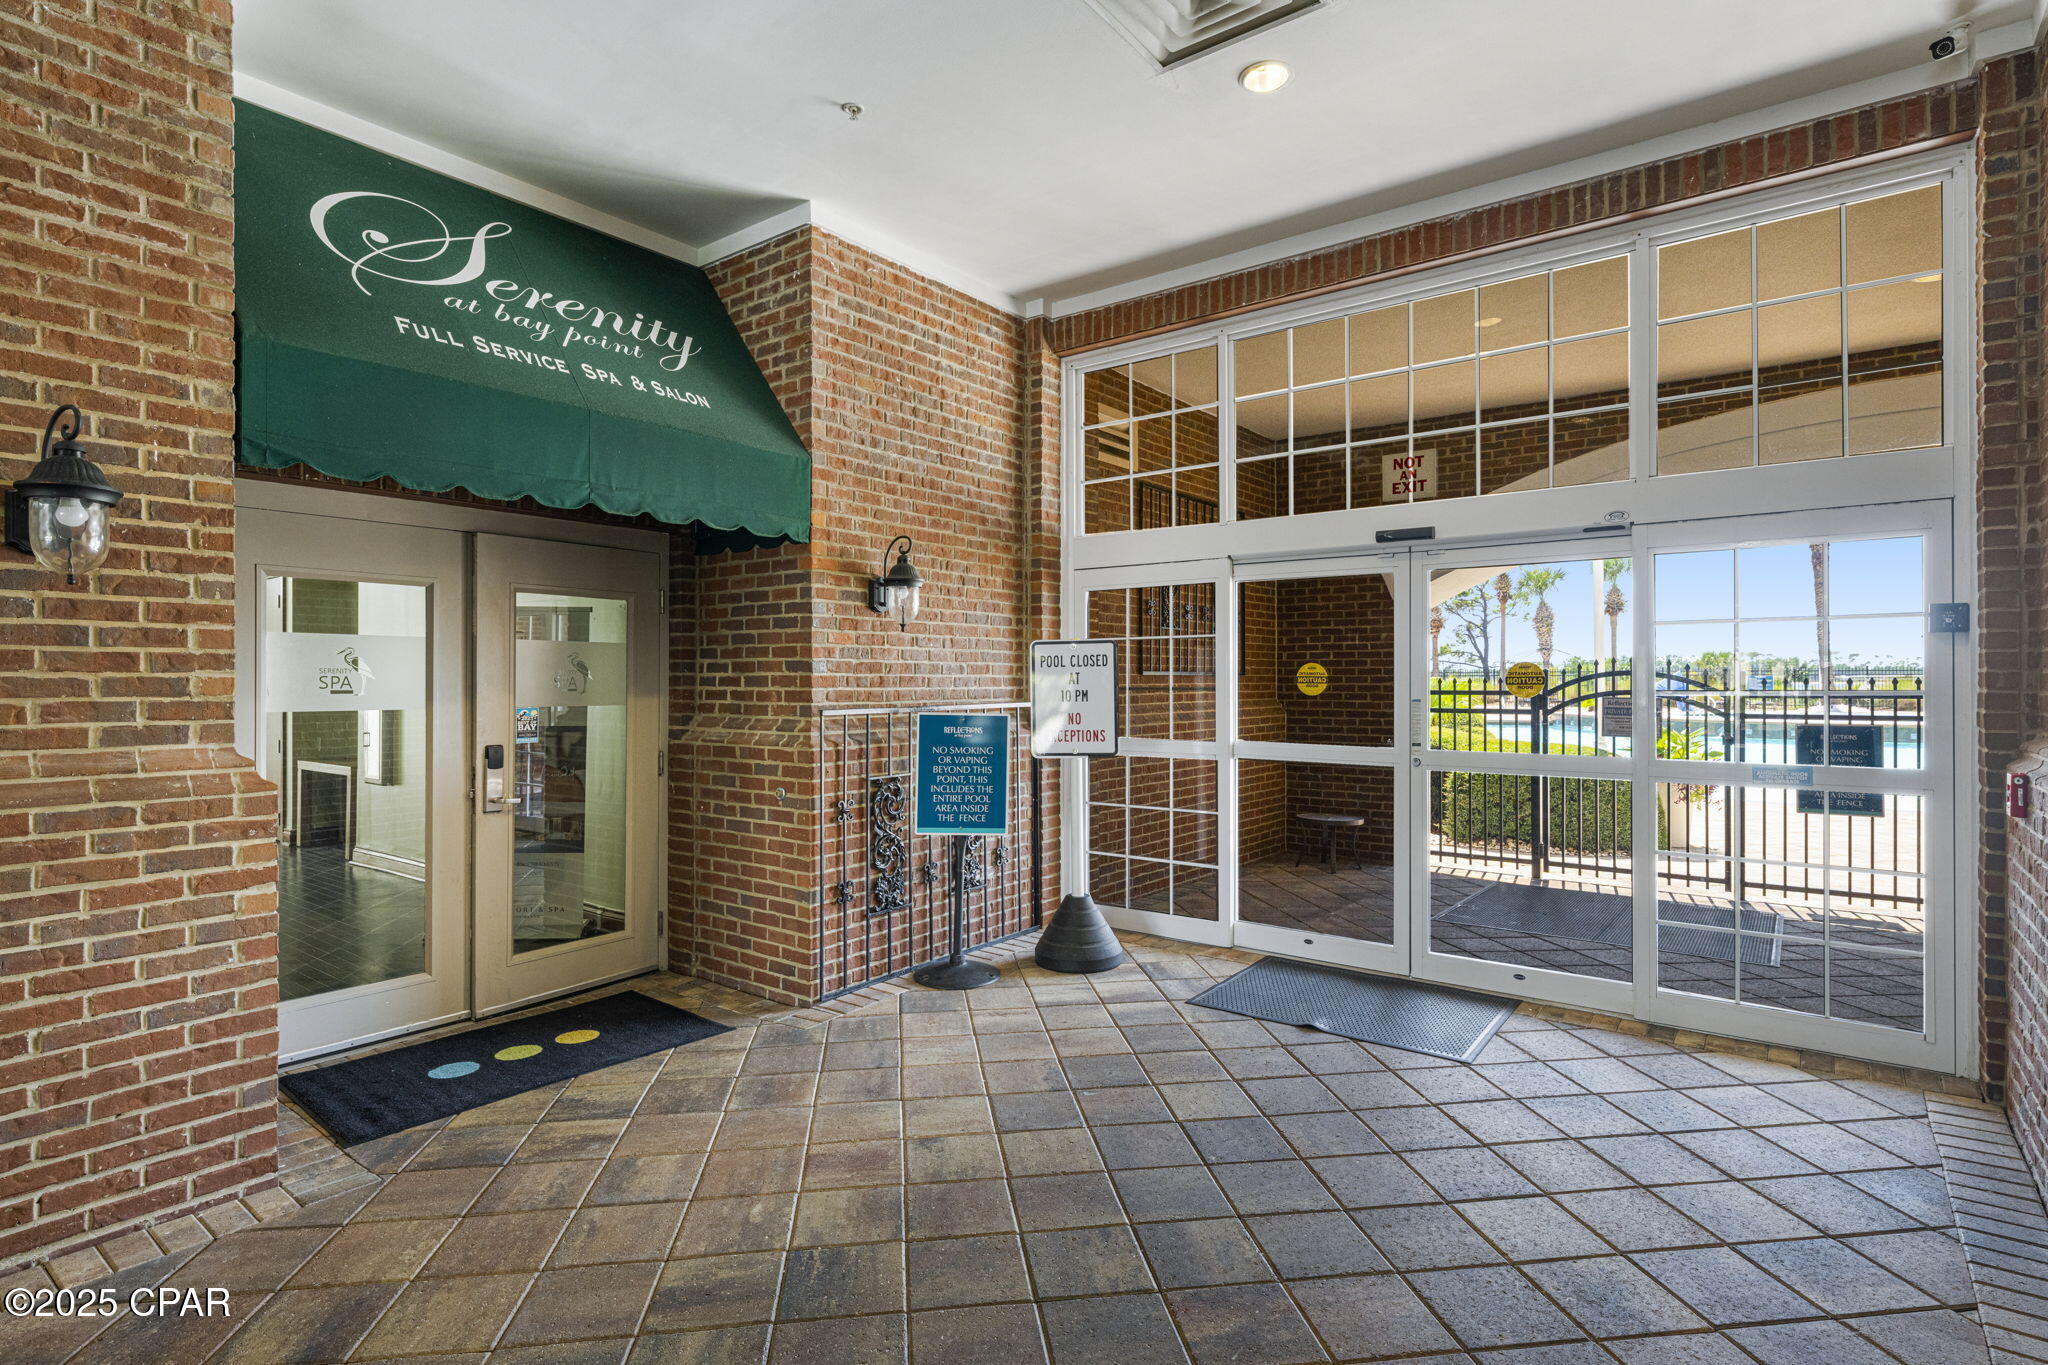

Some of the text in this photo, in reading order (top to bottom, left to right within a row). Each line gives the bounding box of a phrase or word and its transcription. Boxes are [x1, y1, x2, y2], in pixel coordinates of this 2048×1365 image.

[309, 190, 703, 372] Serenity
[443, 296, 645, 359] at bay point
[394, 315, 711, 409] FULL SERVICE SPA & SALON
[1393, 455, 1425, 470] NOT
[1400, 470, 1417, 480] AN
[1392, 479, 1428, 495] EXIT
[1040, 654, 1108, 668] POOL CLOSED
[319, 667, 353, 675] SERENITY
[319, 675, 353, 690] SPA
[1068, 672, 1080, 685] AT
[1061, 689, 1089, 702] 10 PM
[1068, 712, 1082, 725] NO
[943, 726, 983, 734] REFLECTIONS
[1054, 729, 1106, 742] CEPTIONS
[932, 745, 994, 755] NO SMOKING
[1830, 749, 1869, 757] MOKING
[938, 756, 988, 765] OR VAPING
[932, 765, 993, 774] BEYOND THIS
[936, 775, 989, 784] POINT, THIS
[930, 784, 994, 794] INCLUDES THE
[933, 794, 991, 803] ENTIRE POOL
[934, 804, 989, 813] AREA INSIDE
[937, 814, 986, 823] THE FENCE
